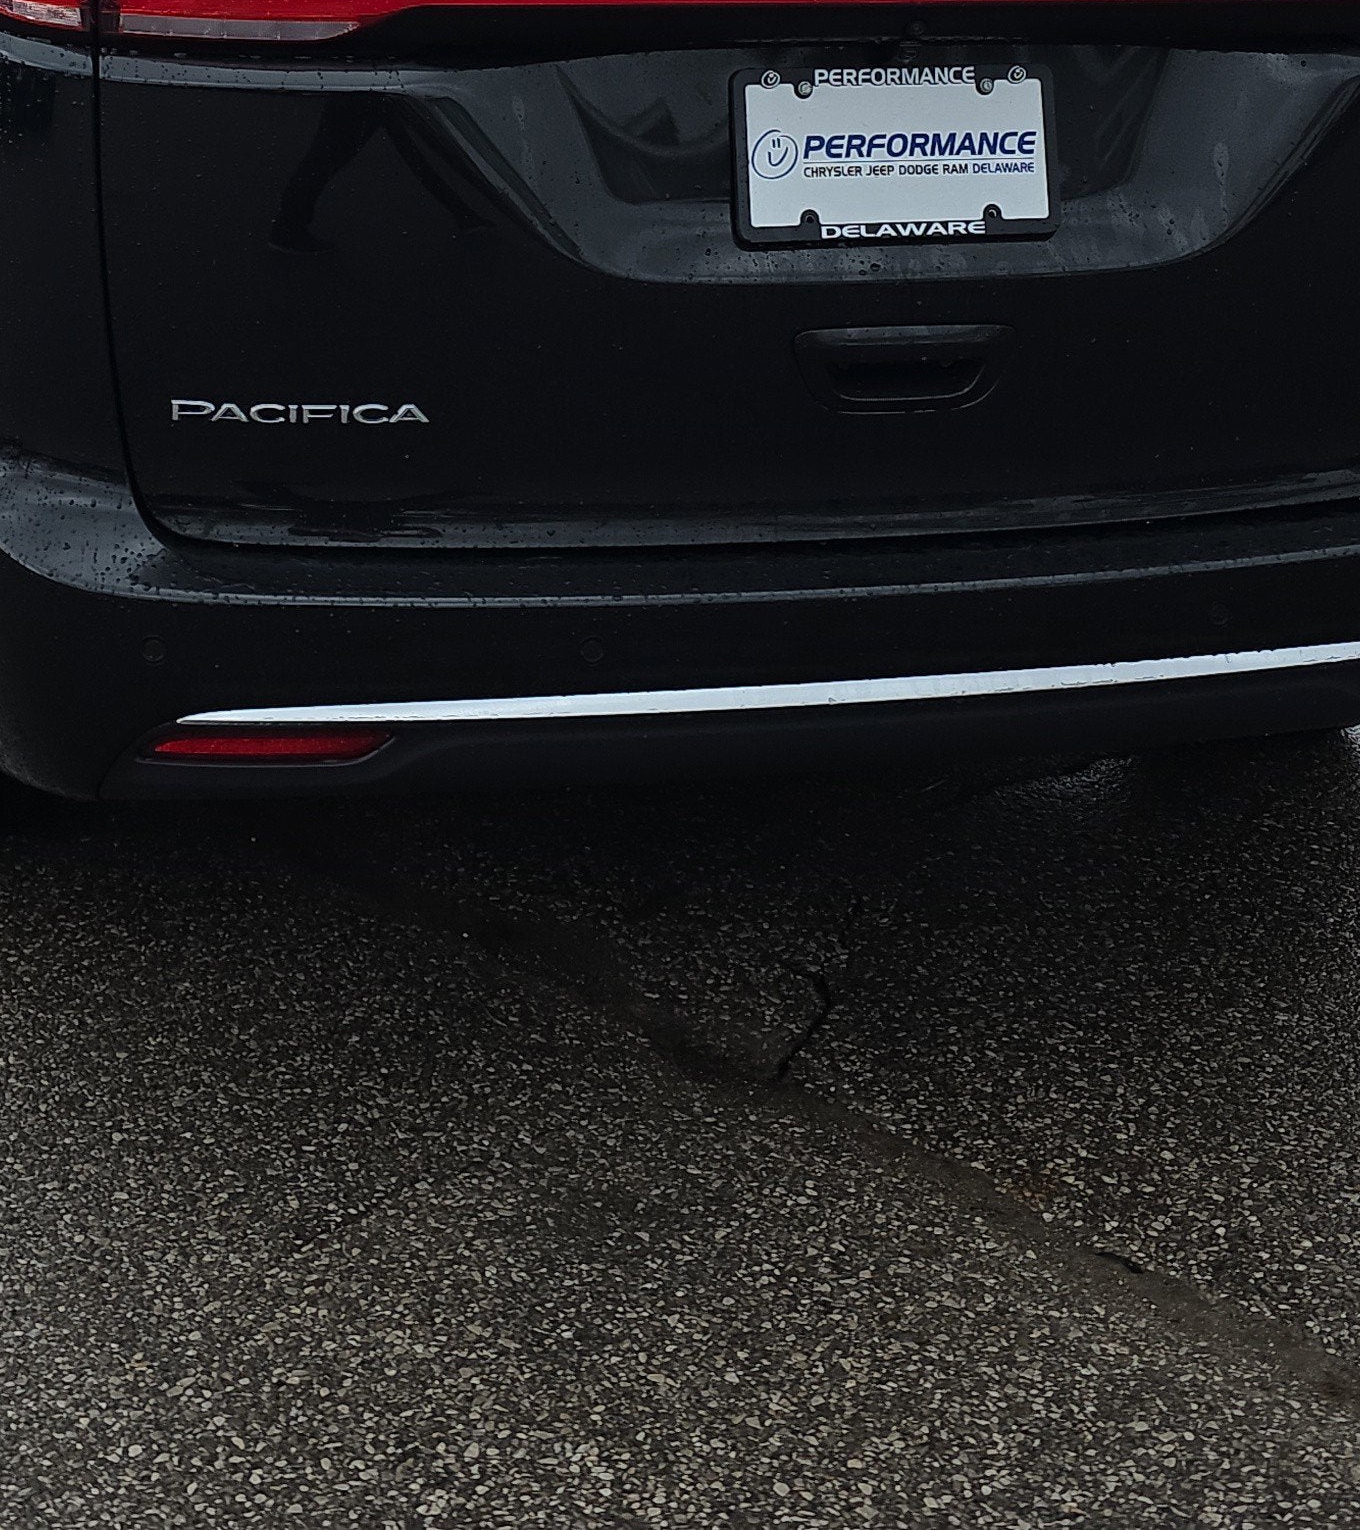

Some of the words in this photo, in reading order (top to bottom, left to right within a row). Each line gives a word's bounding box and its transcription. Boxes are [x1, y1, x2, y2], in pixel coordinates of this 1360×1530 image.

[813, 66, 976, 88] PERFORMANCE
[803, 131, 1037, 160] PERFORMANCE
[803, 166, 863, 178] CHRYSLER
[866, 165, 895, 176] JEEP
[898, 164, 939, 176] DODGE
[943, 163, 969, 174] RAM
[972, 162, 1035, 174] DELAWARE
[820, 220, 986, 240] DELAWARE
[170, 399, 430, 424] PACIFICA
